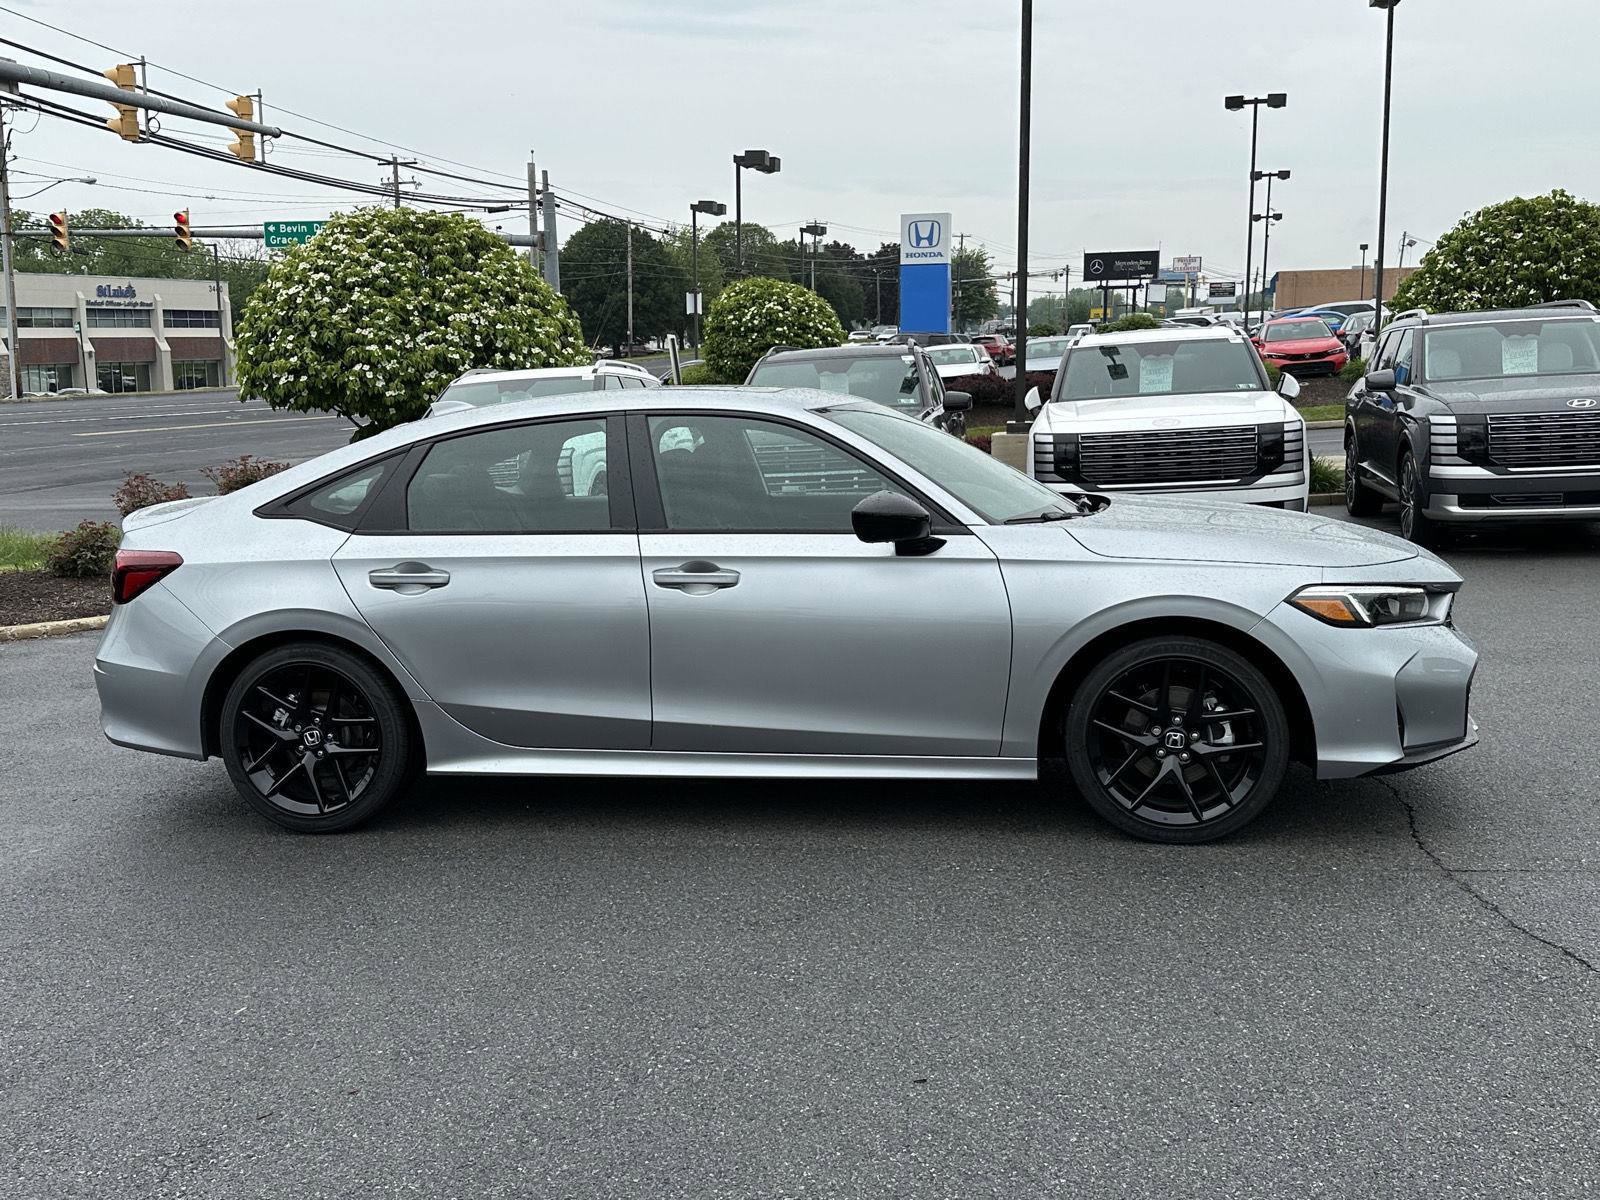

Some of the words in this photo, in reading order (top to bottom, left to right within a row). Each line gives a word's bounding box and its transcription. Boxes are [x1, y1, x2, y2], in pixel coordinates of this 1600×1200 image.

[279, 223, 308, 233] Bevin
[905, 251, 944, 259] HONDA
[208, 285, 224, 293] 340
